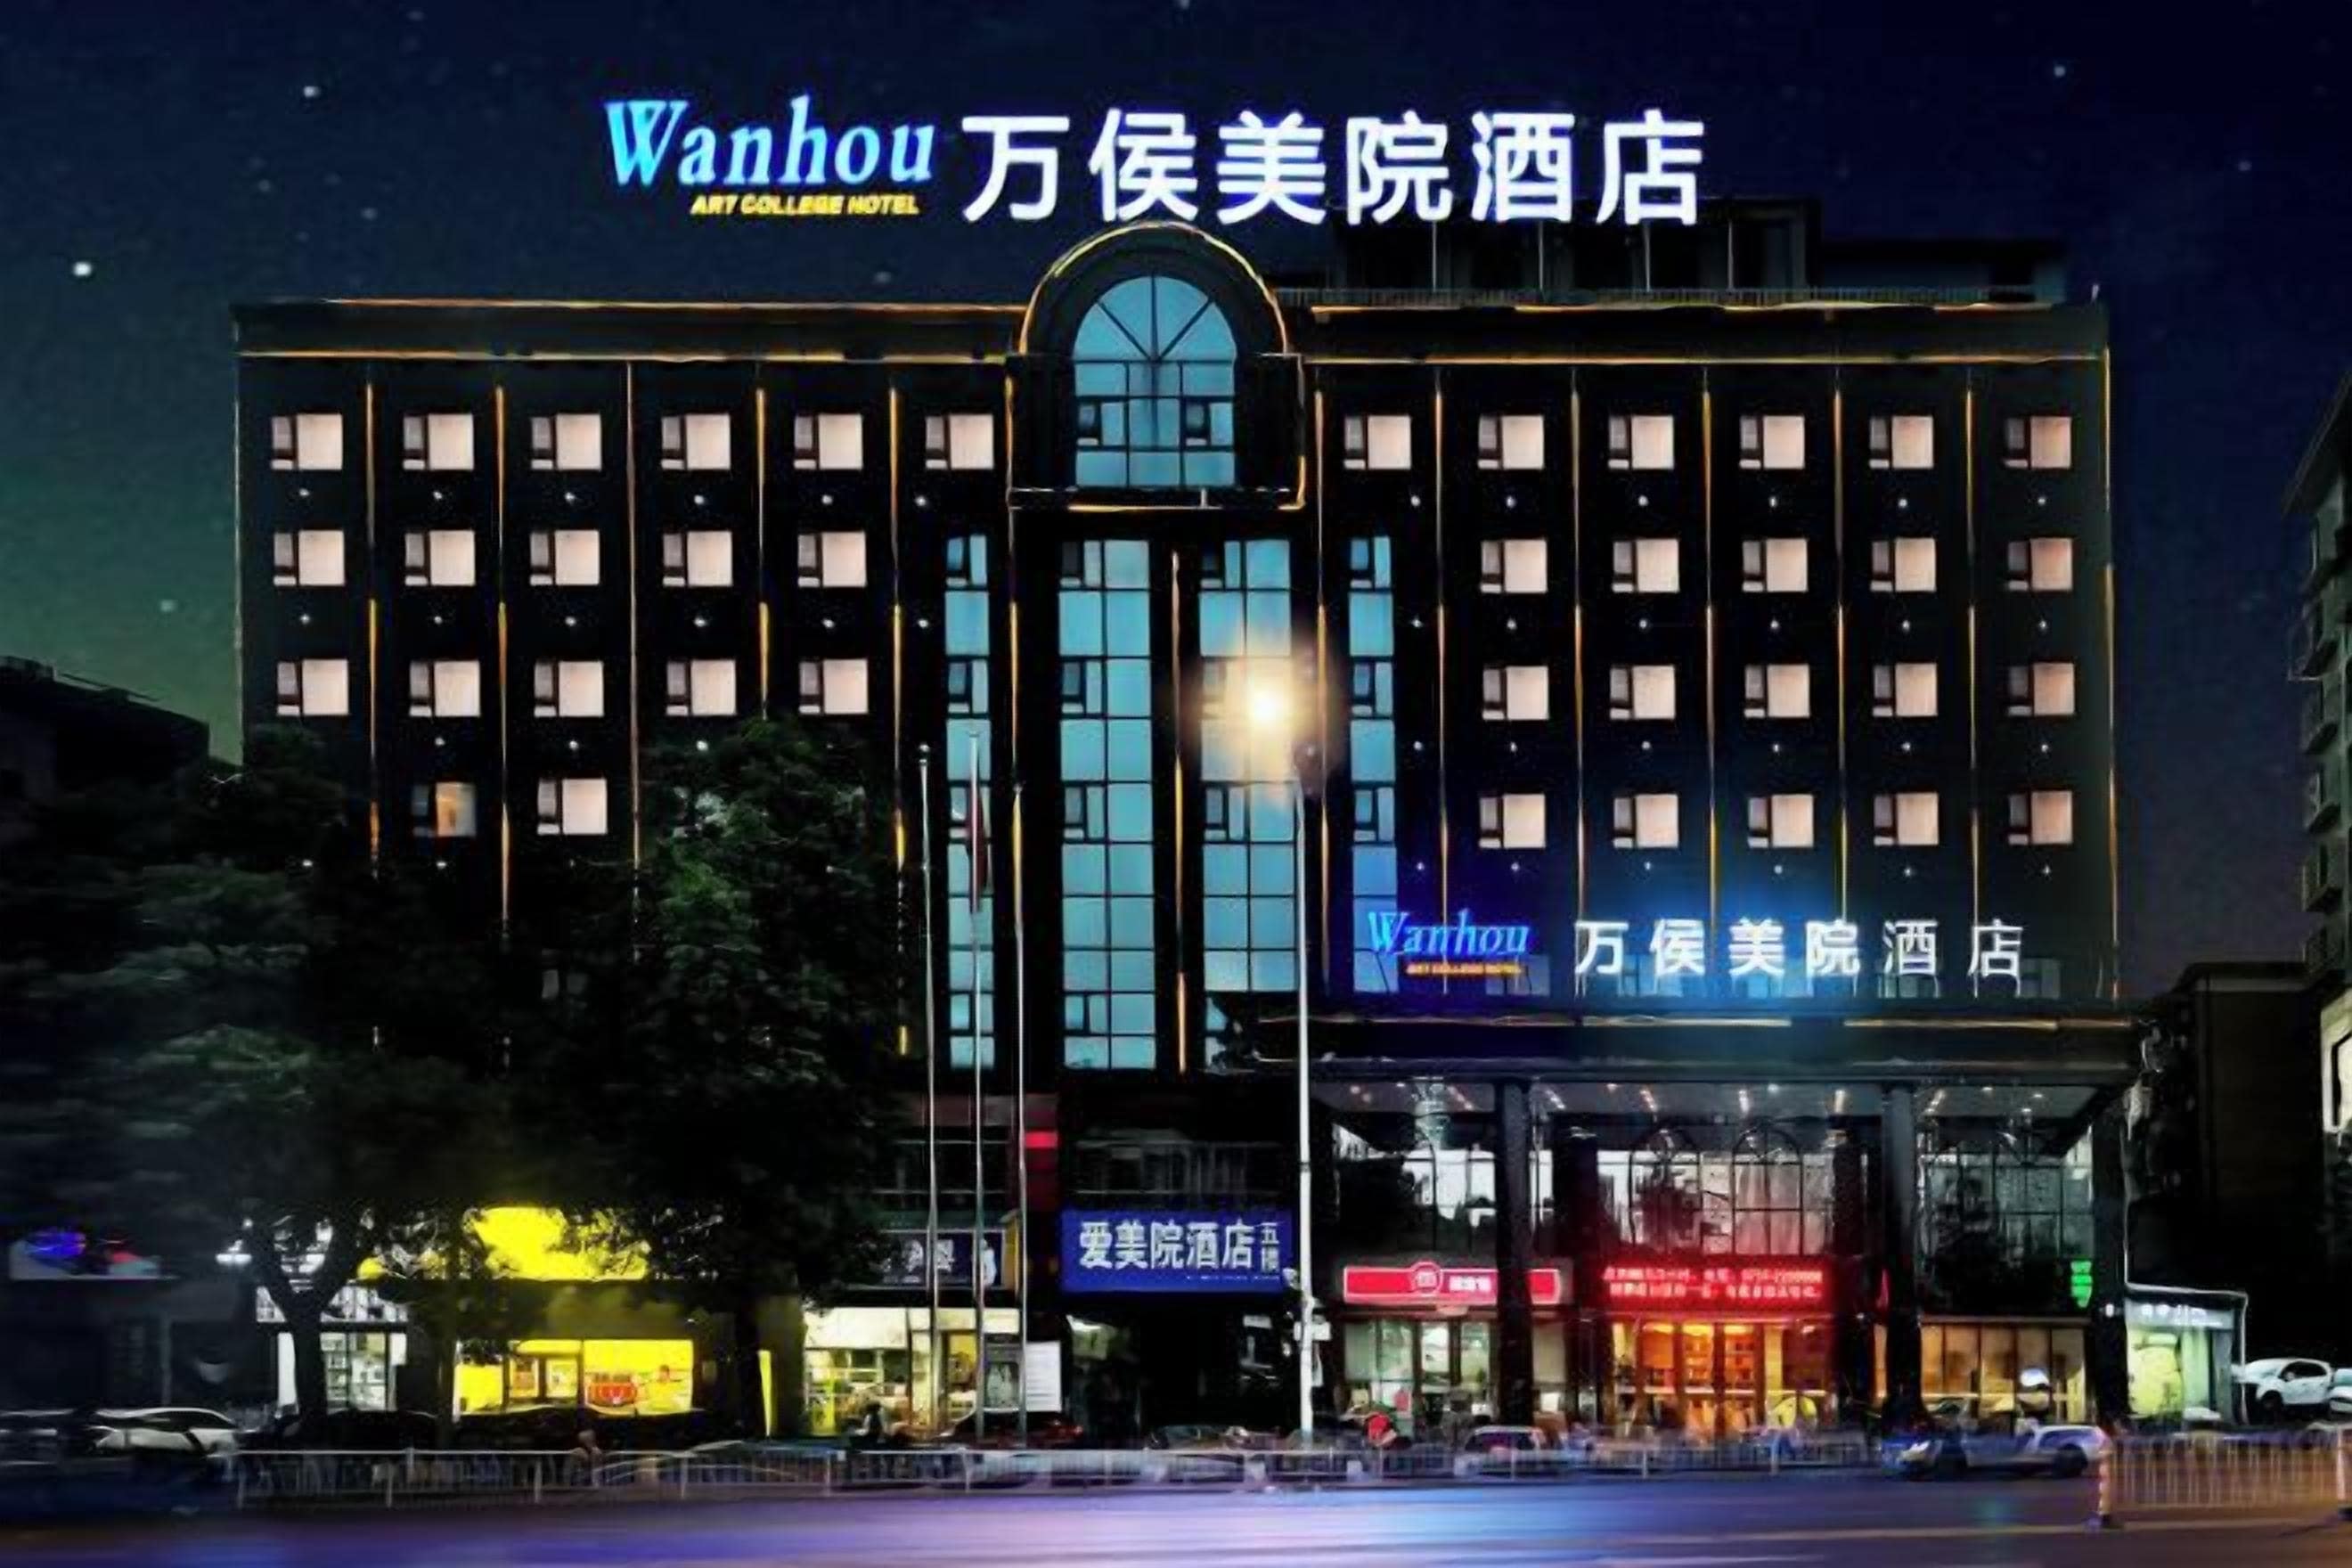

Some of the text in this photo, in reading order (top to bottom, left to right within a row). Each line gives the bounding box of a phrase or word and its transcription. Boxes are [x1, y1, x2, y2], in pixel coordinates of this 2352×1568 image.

[605, 94, 935, 187] Wanhou
[960, 108, 1707, 225] 万侯美院酒店
[690, 194, 919, 215] ART COLLEGE HOTEL
[1367, 908, 1530, 956] Wanhou
[1575, 918, 2024, 978] 万侯美院酒店
[1079, 1218, 1255, 1270] 爱美院酒店
